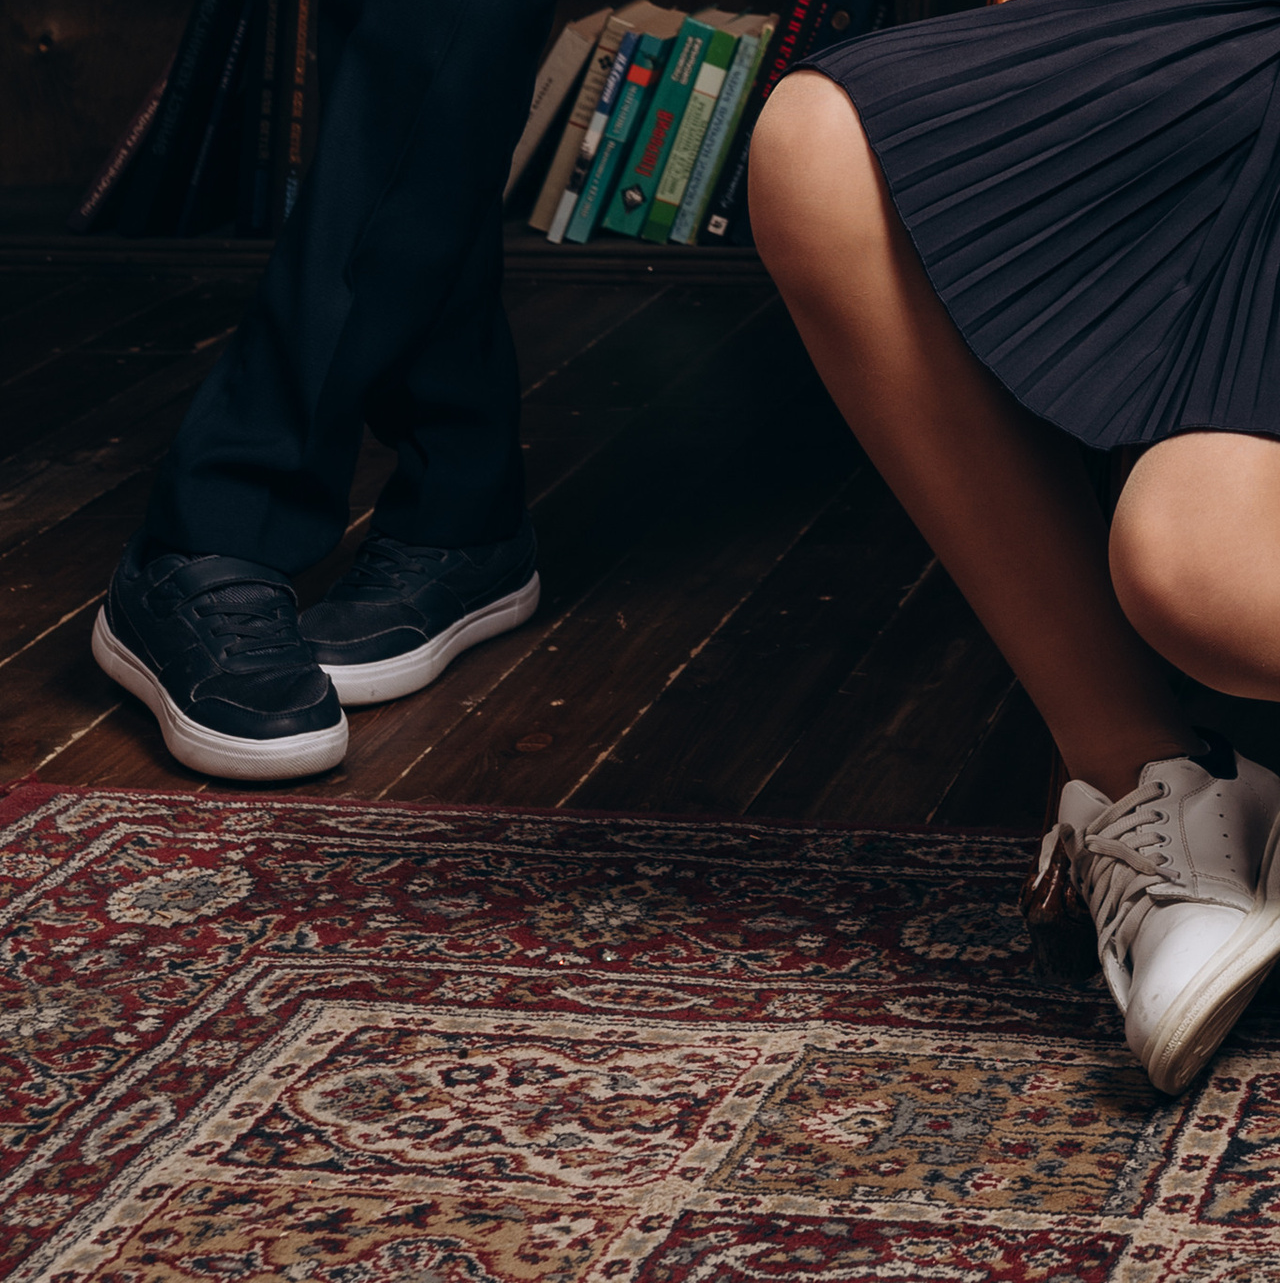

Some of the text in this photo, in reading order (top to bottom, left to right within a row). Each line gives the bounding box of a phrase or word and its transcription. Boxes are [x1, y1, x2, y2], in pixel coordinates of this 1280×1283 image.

[677, 37, 705, 86] школьника
[149, 90, 185, 157] ЭРНЕСТ
[632, 107, 676, 178] ГЕОГРАФИЯ
[698, 103, 728, 158] НАРОДОВ
[720, 68, 743, 104] МИРА
